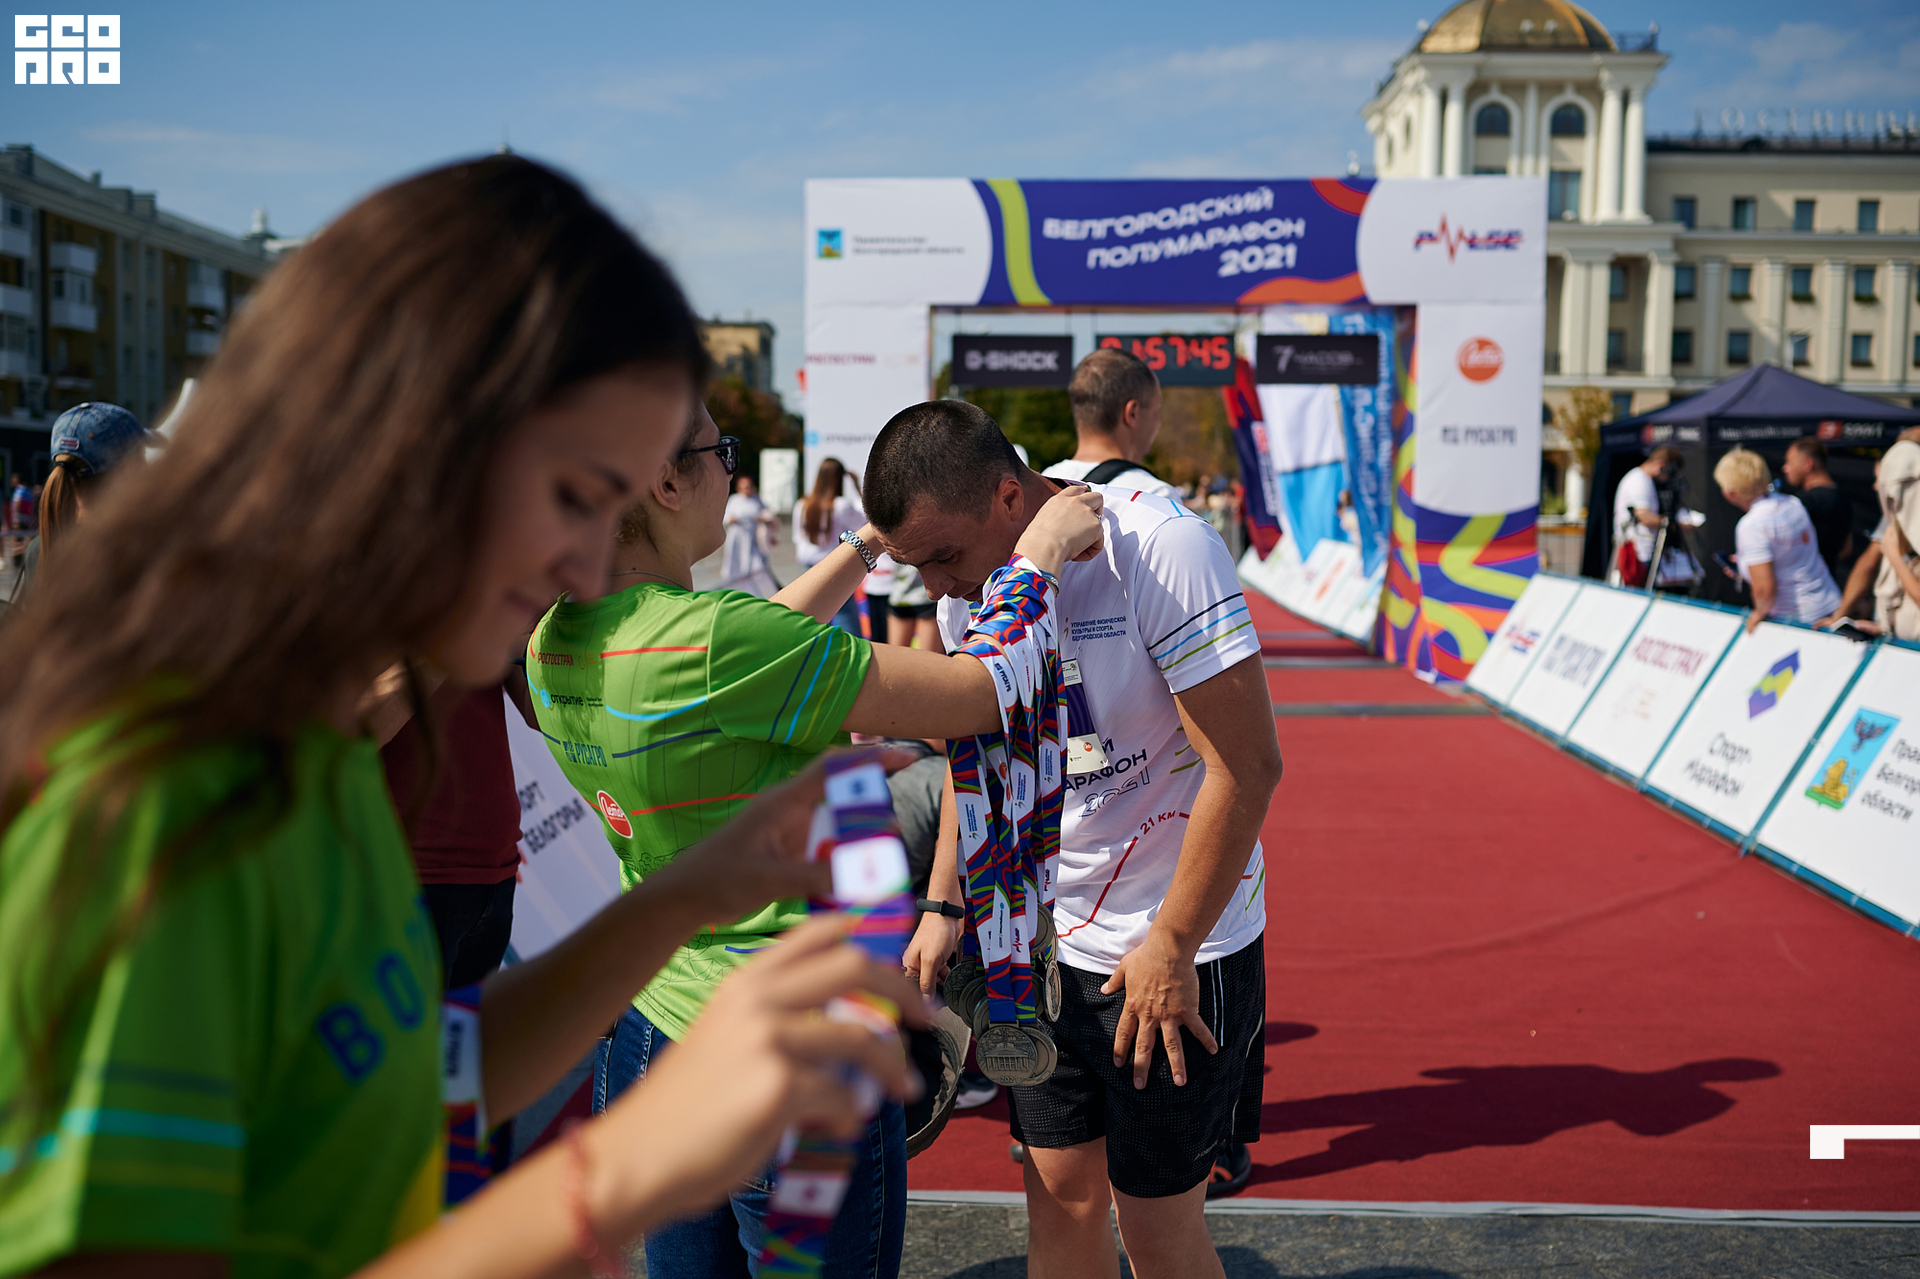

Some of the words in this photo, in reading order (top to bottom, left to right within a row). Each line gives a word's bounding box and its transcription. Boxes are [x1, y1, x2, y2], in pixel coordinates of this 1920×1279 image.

[1043, 186, 1274, 240] БЕЛГОРОДСКИЙ
[1087, 217, 1305, 269] ПОЛУМАРАФОН
[1218, 243, 1297, 277] 2021
[1065, 749, 1147, 792] АРАФОН
[1140, 817, 1156, 835] 21
